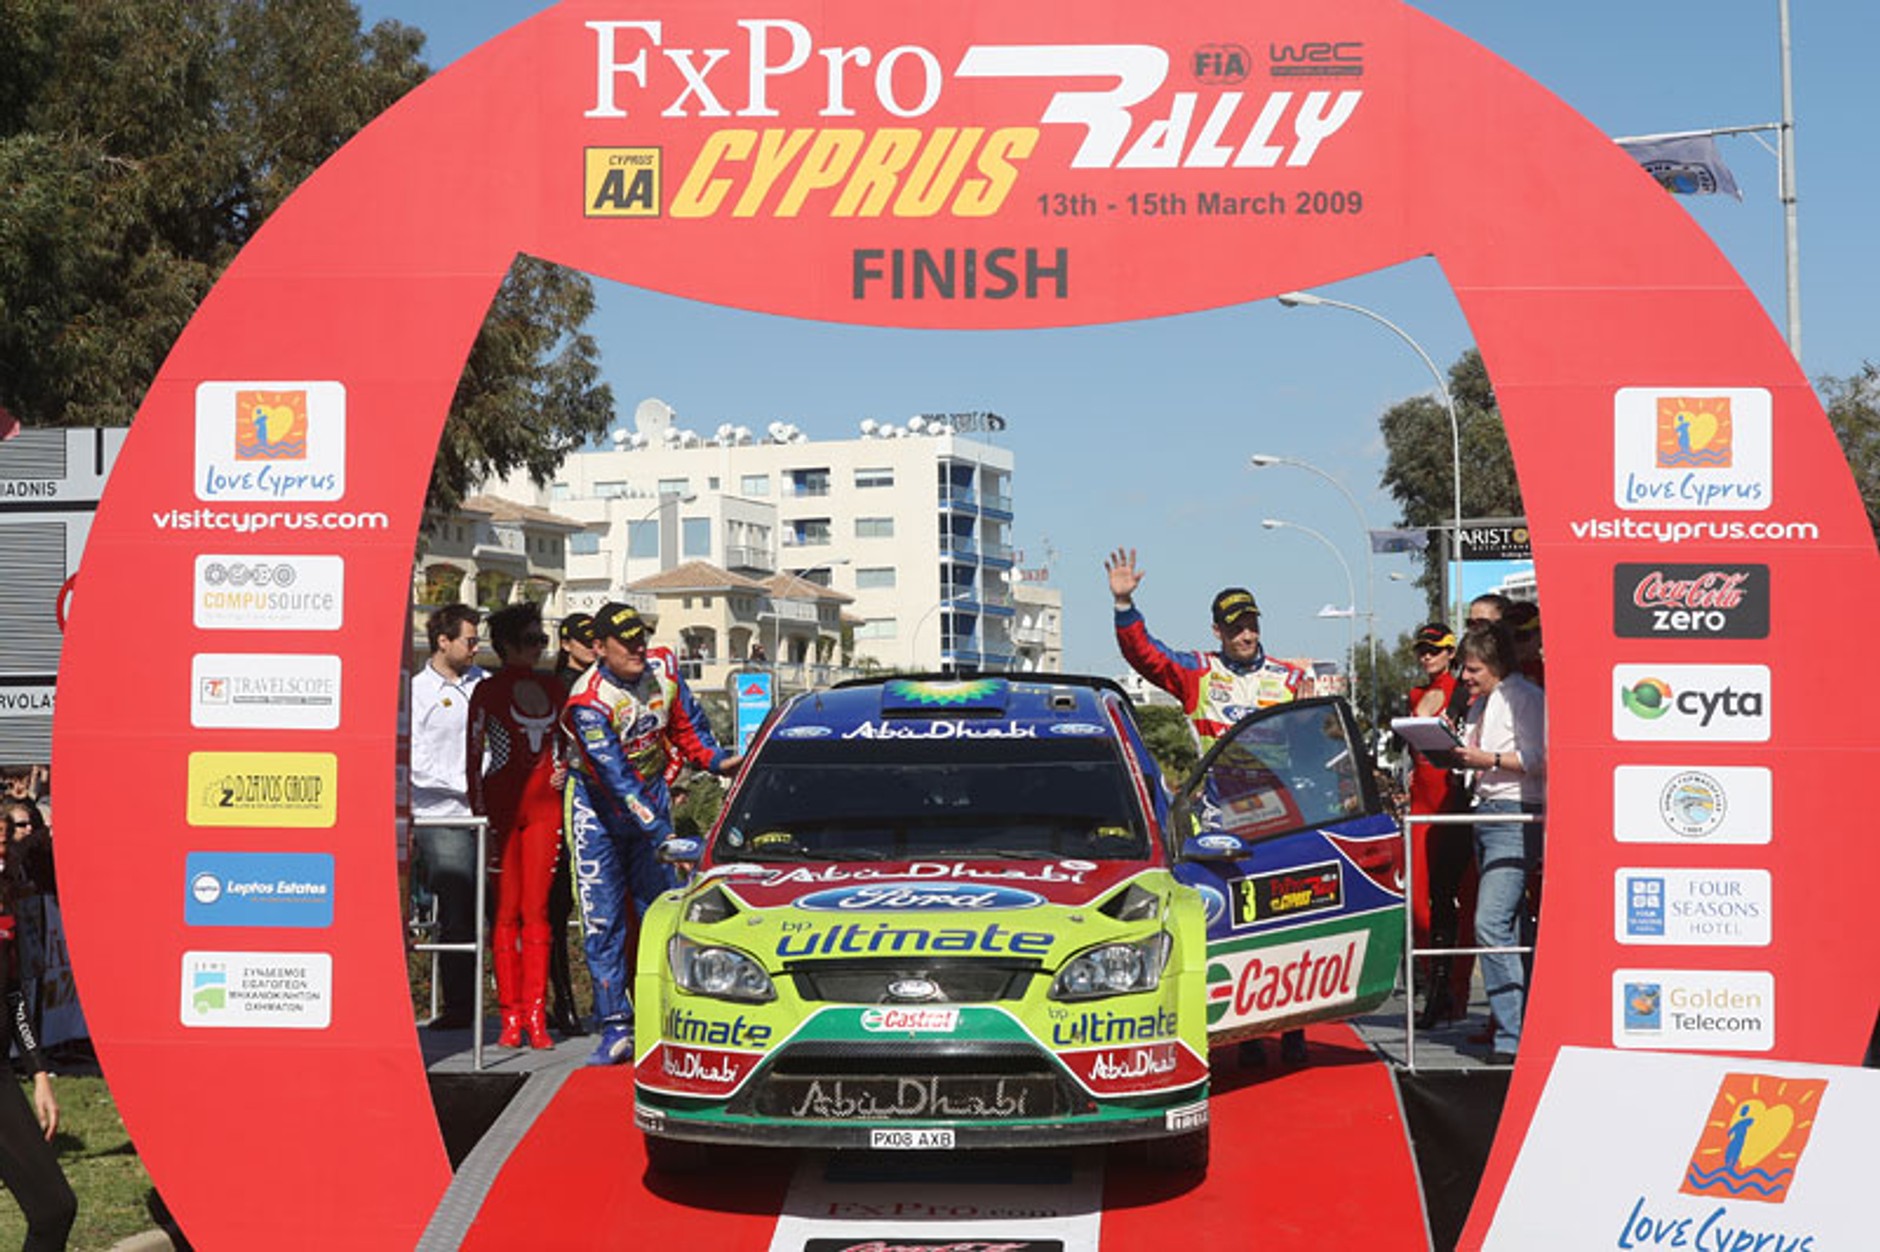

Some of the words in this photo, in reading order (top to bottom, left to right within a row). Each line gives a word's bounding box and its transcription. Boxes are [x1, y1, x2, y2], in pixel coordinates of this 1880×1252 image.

[1270, 42, 1364, 62] WRC
[584, 19, 943, 118] FxPro
[955, 44, 1363, 168] RALLY
[609, 154, 654, 165] CYPRUS
[669, 127, 1041, 218] CYPRUS
[593, 168, 653, 208] AA
[1037, 193, 1100, 216] 13th
[1126, 193, 1188, 215] 15th
[1197, 192, 1286, 215] March
[1295, 191, 1363, 214] 2009
[852, 247, 1069, 300] FINISH
[257, 465, 335, 496] Cyprus
[1680, 472, 1762, 505] Cyprus
[153, 509, 389, 533] visitcyprus.com
[1570, 518, 1819, 543] visitcyprus.com
[1633, 571, 1750, 608] Coca-Cola
[1653, 610, 1725, 631] zero
[1676, 686, 1763, 727] cyta
[931, 720, 1036, 738] Dhabi
[908, 862, 1085, 885] Dhabi
[839, 887, 998, 909] Ford
[1689, 880, 1742, 896] FOUR
[1241, 881, 1256, 922] 3
[1672, 902, 1760, 917] SEASONS
[776, 922, 1055, 956] ultimate
[782, 921, 812, 933] bp
[1690, 922, 1742, 935] HOTEL
[1235, 942, 1355, 1015] Castrol
[1670, 988, 1761, 1009] Golden
[885, 1010, 952, 1028] Castrol
[1053, 1006, 1176, 1045] ultimate
[1672, 1013, 1761, 1031] Telecom
[898, 1076, 1028, 1116] Dhabi
[874, 1132, 913, 1146] PX08
